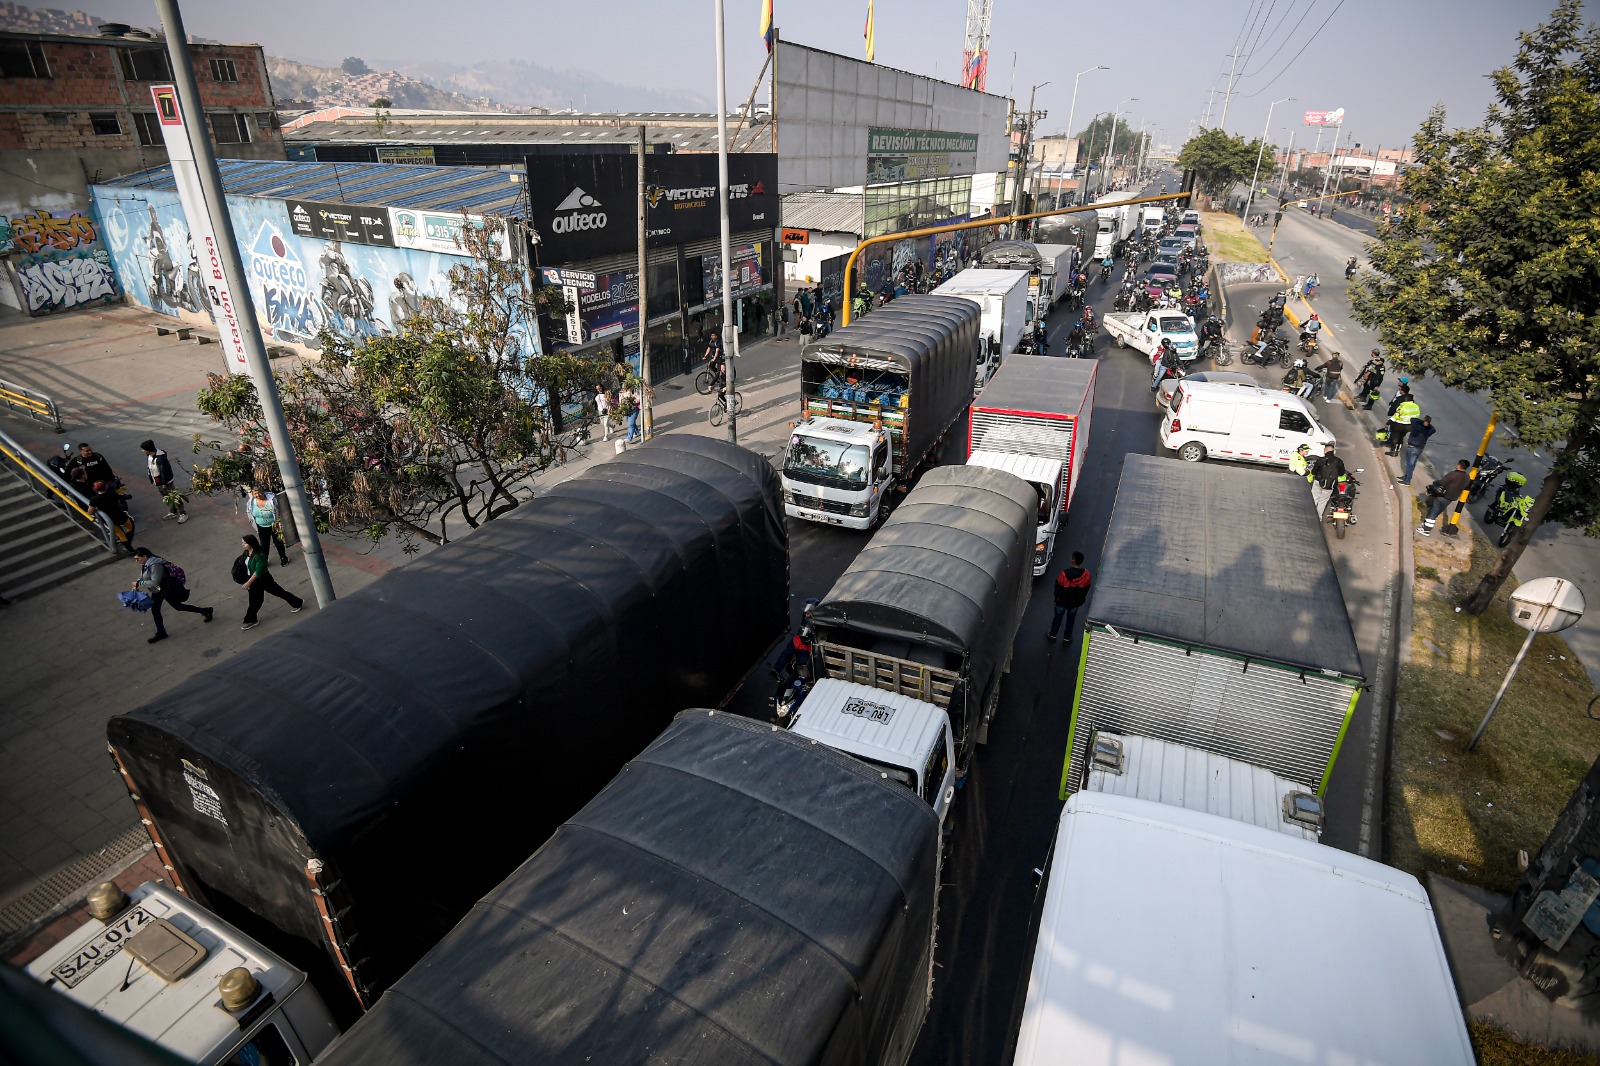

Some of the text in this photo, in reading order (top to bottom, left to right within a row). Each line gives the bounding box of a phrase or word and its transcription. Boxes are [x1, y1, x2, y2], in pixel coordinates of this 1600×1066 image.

[872, 132, 976, 150] REVISIÓN TÉCNICO MECÁNICA
[663, 183, 749, 201] VICTORY TVS
[552, 211, 608, 234] auteco
[434, 224, 450, 239] 315
[784, 232, 805, 242] KTM
[253, 257, 306, 288] auteco
[560, 270, 595, 281] SERVICIO
[562, 278, 595, 289] TECNICO
[205, 236, 246, 364] Estación Bosa
[580, 290, 611, 305] MODELOS
[611, 279, 639, 301] 2025
[846, 703, 866, 715] 823
[870, 710, 890, 721] LRU
